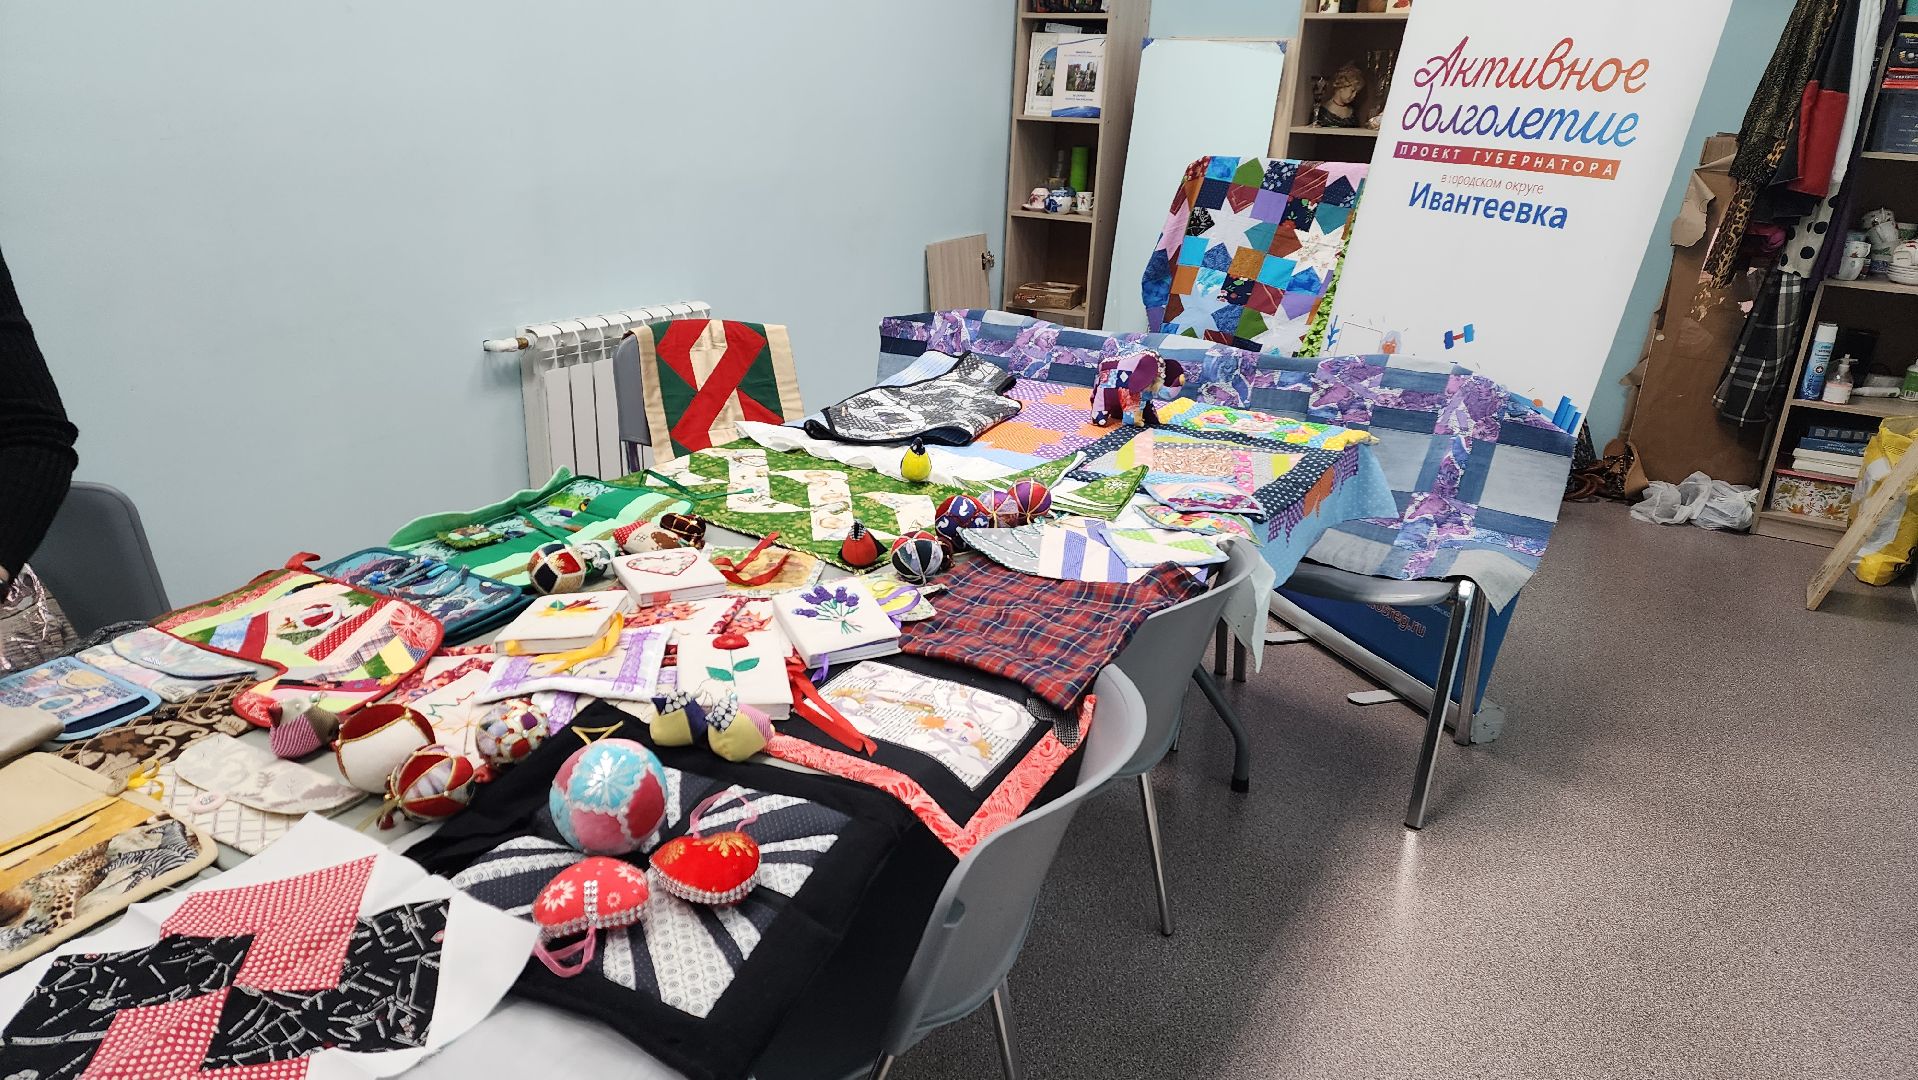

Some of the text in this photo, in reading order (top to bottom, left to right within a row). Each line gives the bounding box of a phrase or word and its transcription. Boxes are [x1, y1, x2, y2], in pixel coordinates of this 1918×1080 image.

[1413, 35, 1649, 94] Активное
[1402, 83, 1639, 147] долголетие
[1399, 145, 1613, 176] ПРОЕКТ ГУБЕРНАТОРА
[1408, 181, 1568, 230] Ивантеевка
[1448, 175, 1502, 189] городском
[1505, 181, 1544, 196] округе
